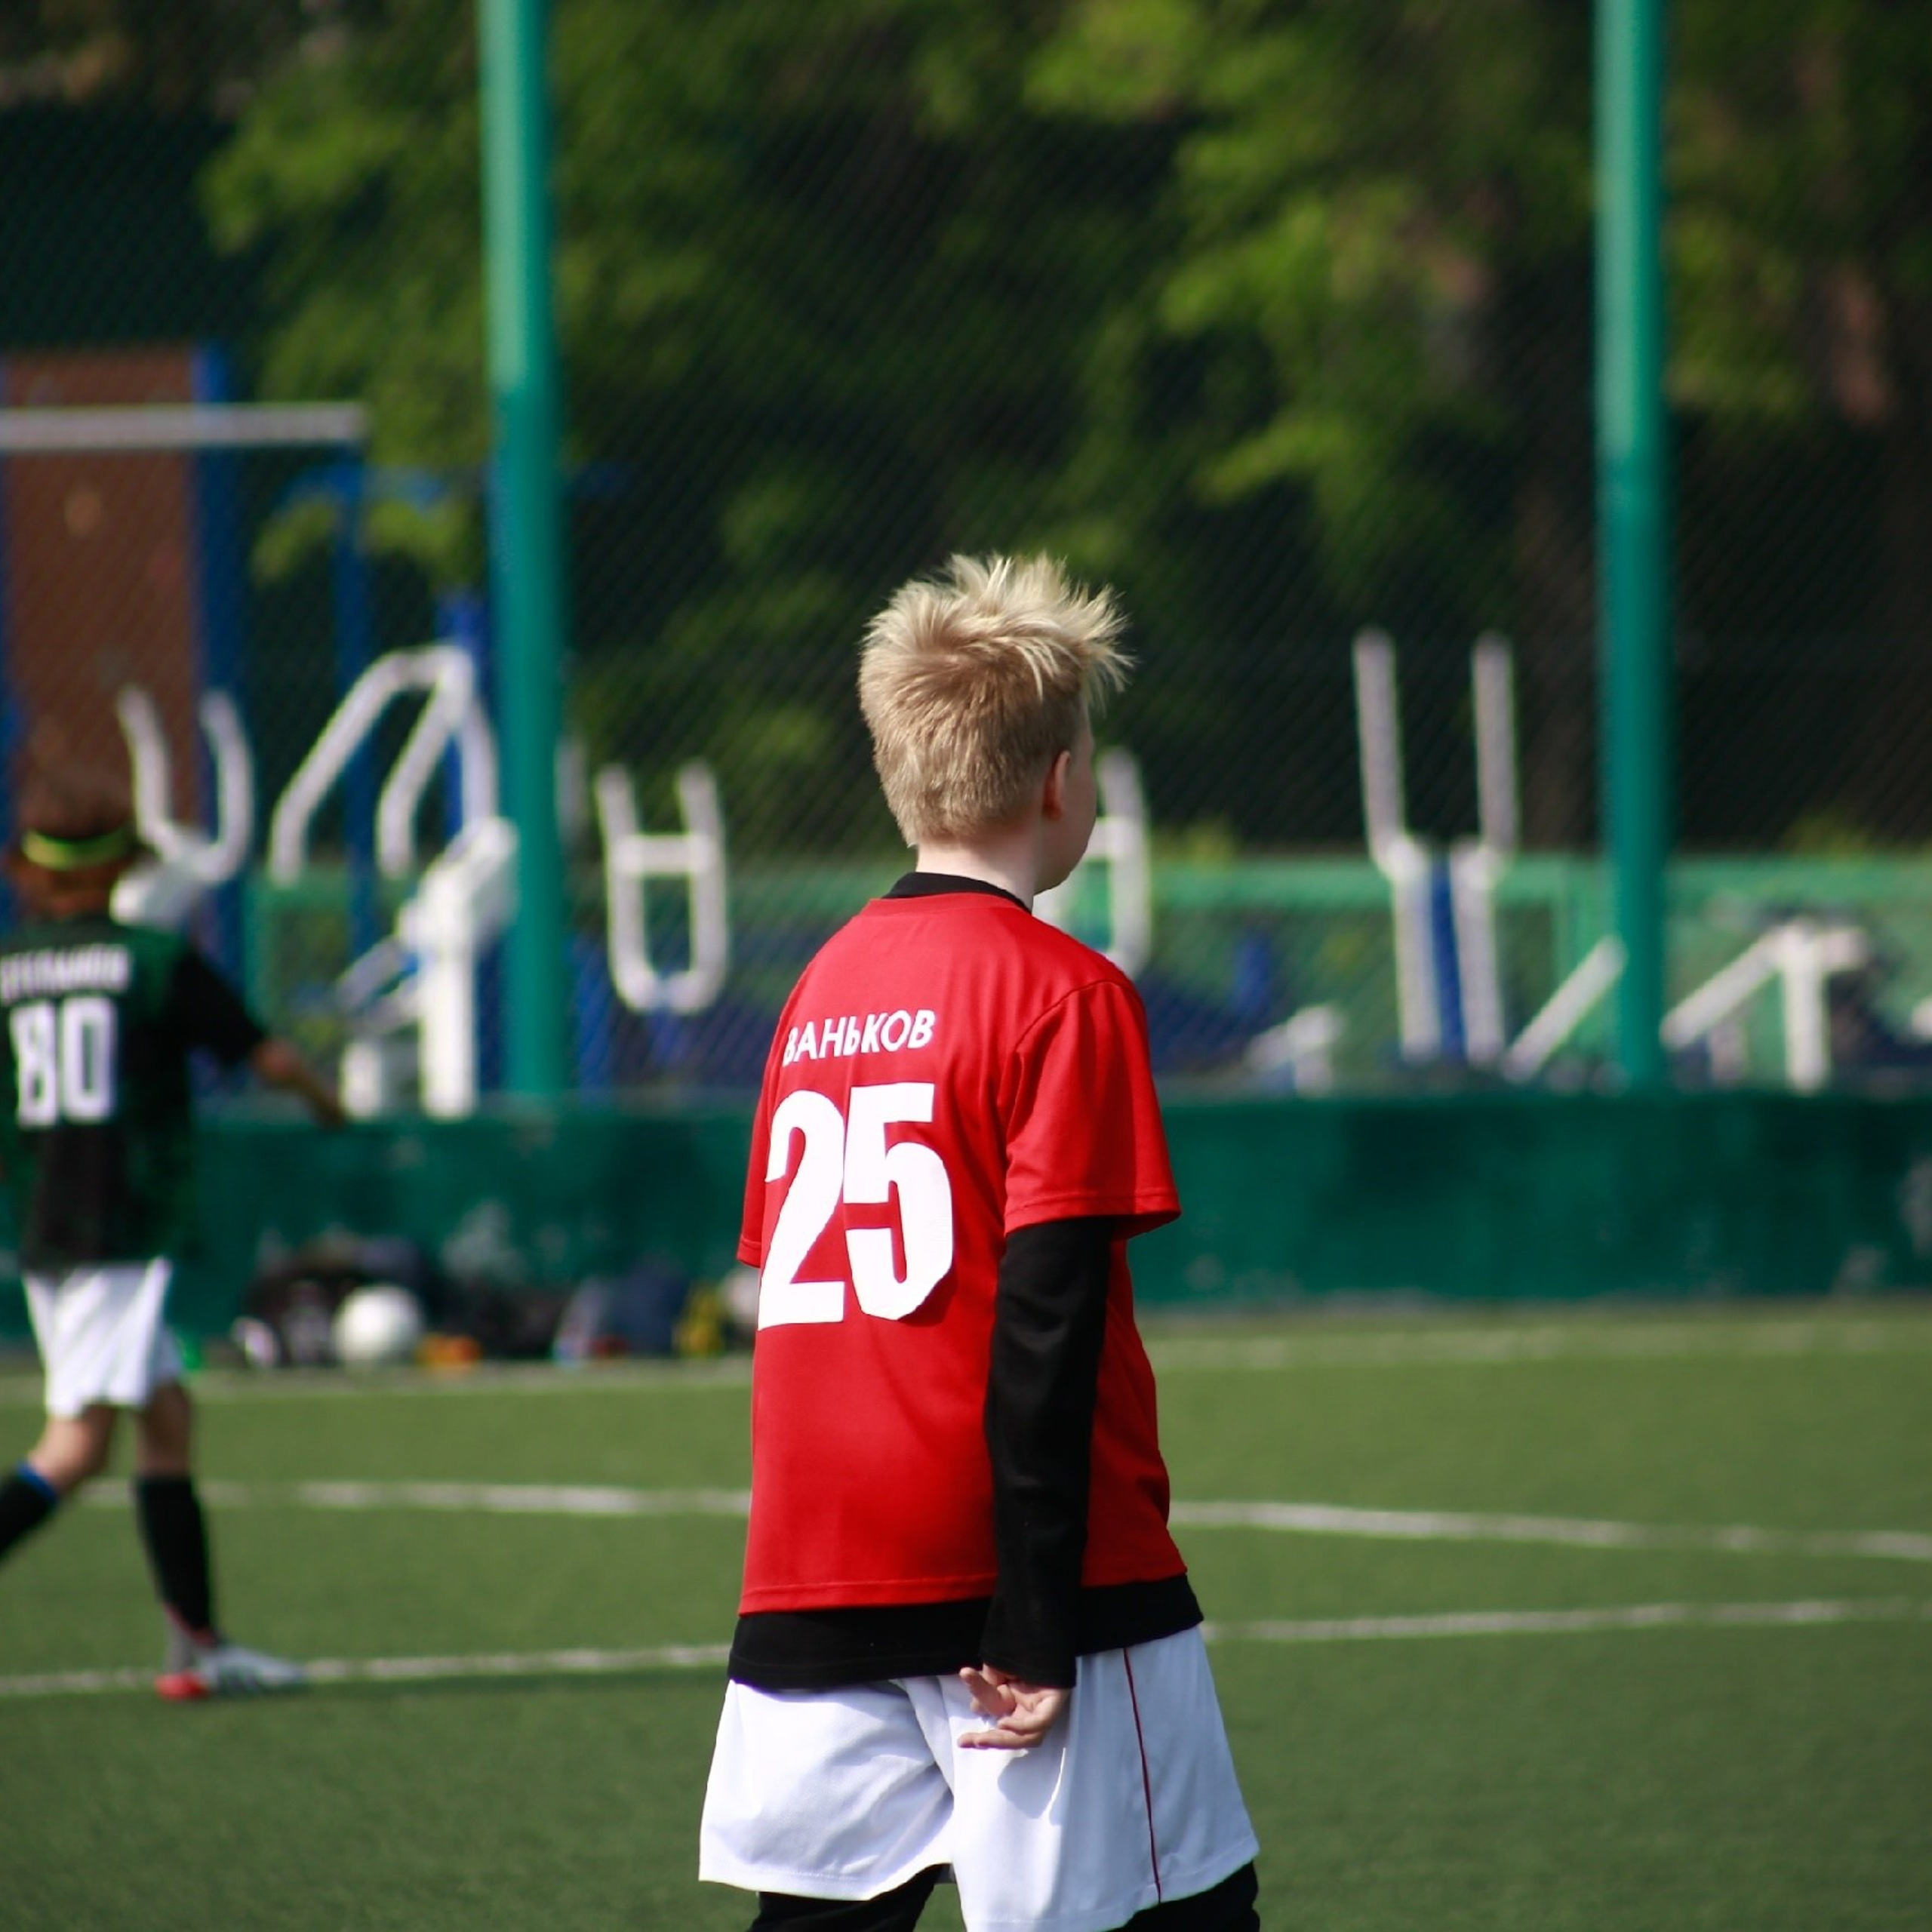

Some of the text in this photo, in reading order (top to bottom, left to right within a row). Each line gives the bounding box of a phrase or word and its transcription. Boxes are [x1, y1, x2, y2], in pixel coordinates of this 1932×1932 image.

[10, 997, 117, 1126] 80
[782, 1009, 936, 1067] ВАНЬКОВ
[758, 1082, 954, 1331] 25
